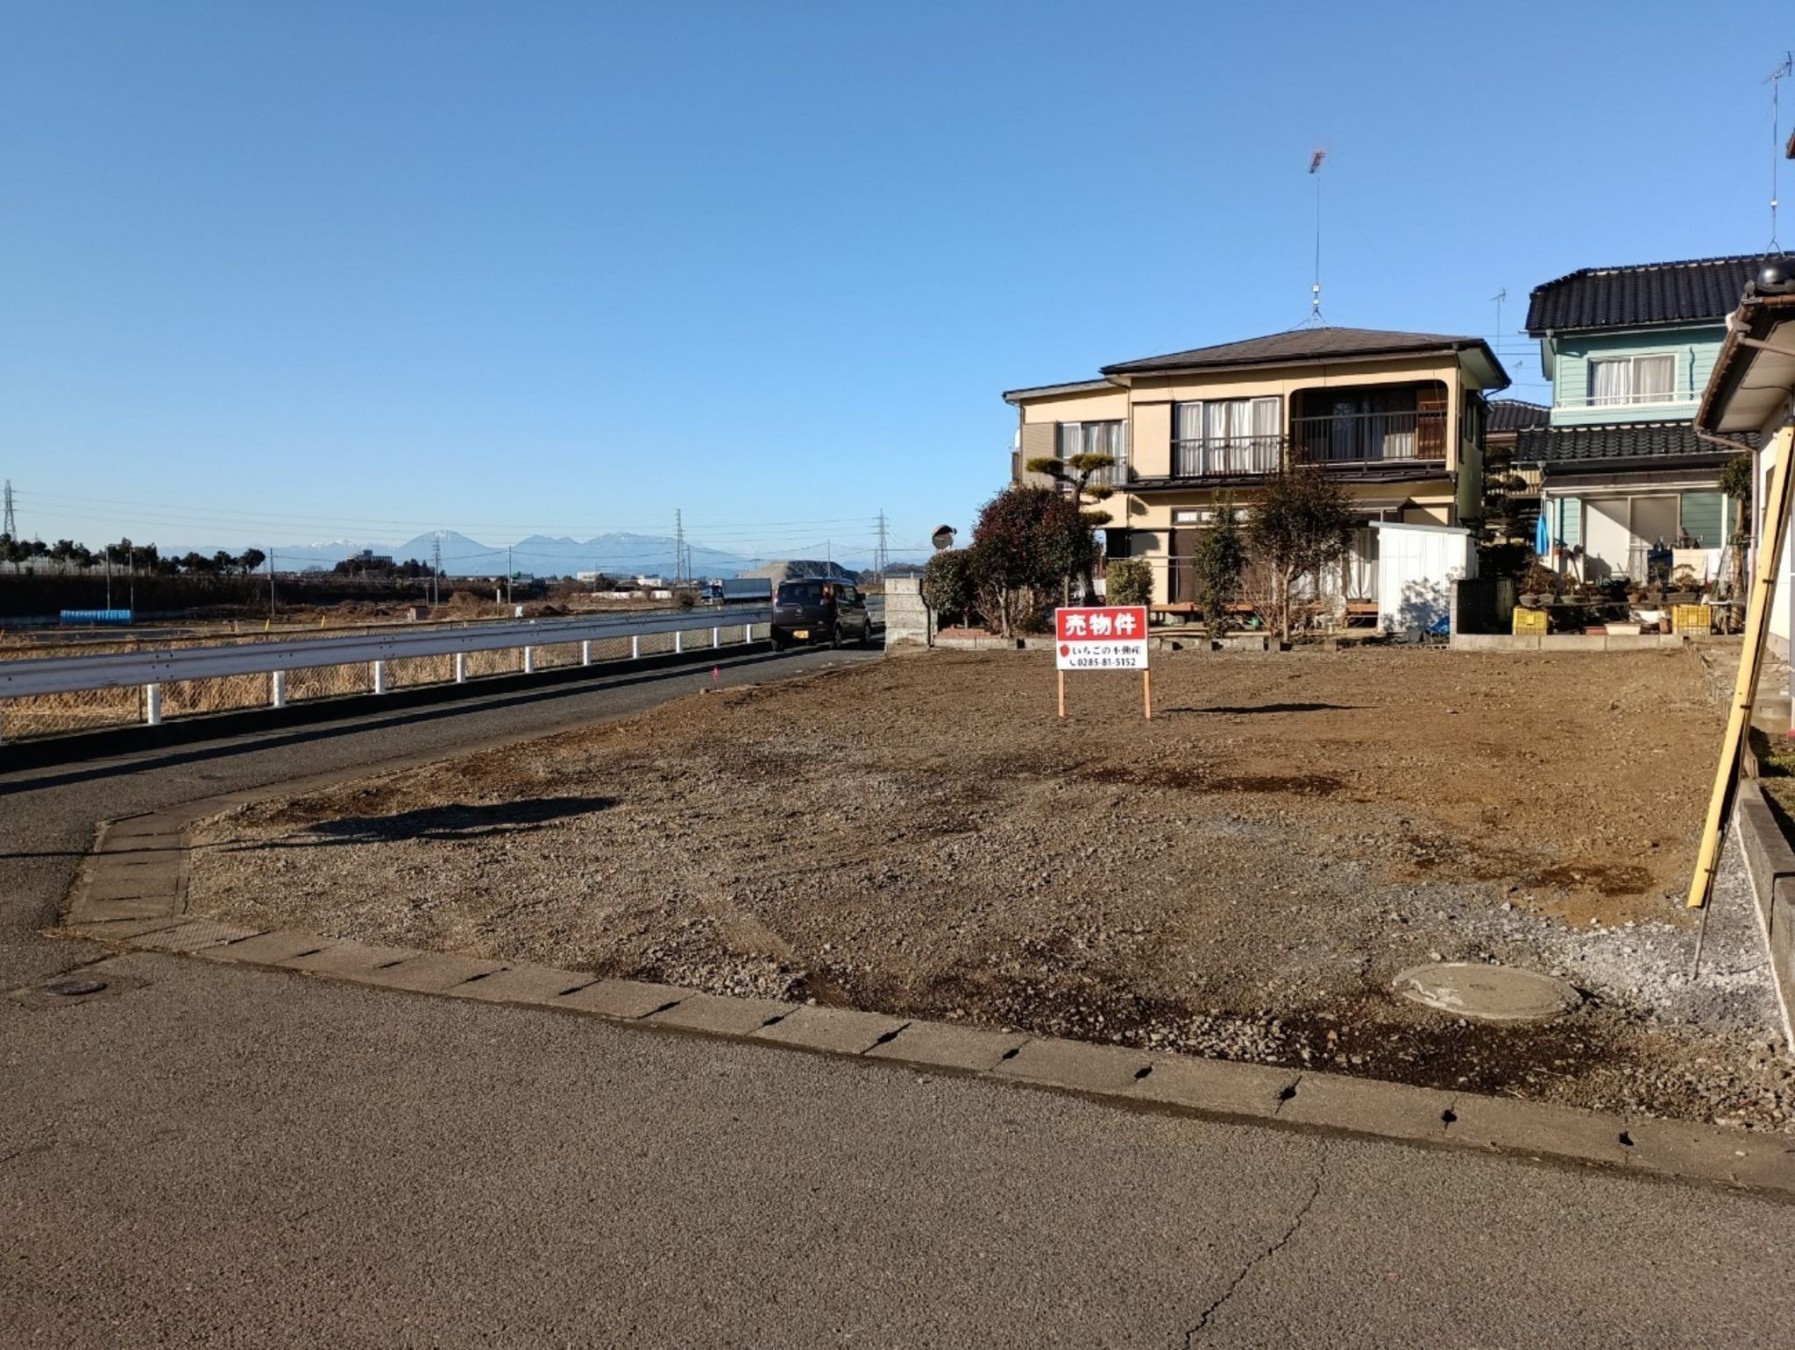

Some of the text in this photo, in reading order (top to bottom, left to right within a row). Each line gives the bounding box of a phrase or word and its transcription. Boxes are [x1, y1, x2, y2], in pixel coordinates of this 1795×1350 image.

[1066, 612, 1136, 636] 売物件
[1077, 658, 1136, 667] 0285-81-5152
